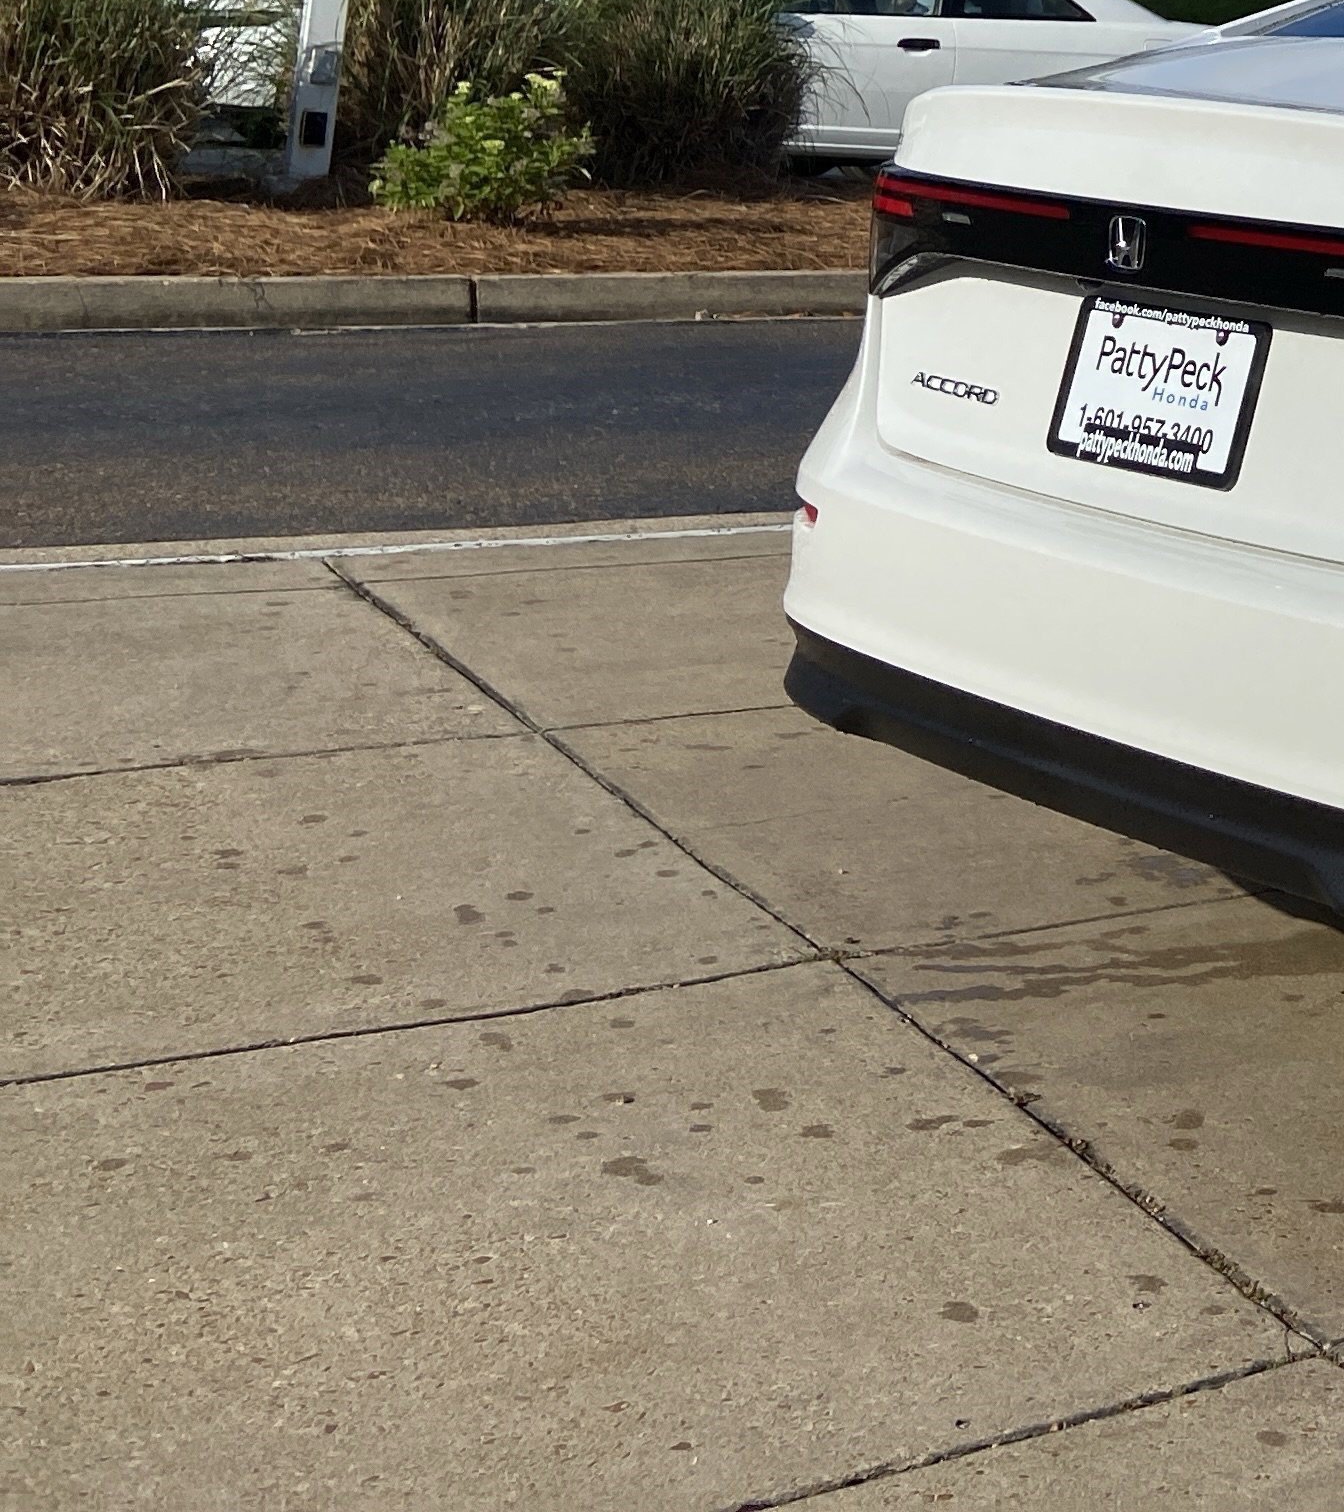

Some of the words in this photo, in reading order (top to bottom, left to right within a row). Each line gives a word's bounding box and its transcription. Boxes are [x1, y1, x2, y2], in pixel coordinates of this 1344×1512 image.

[1094, 297, 1250, 334] facebook.com/pattypeckhonda
[911, 371, 1000, 406] ACCORD
[1152, 386, 1209, 411] Honda
[1076, 428, 1195, 474] pattypeckhonda.com
